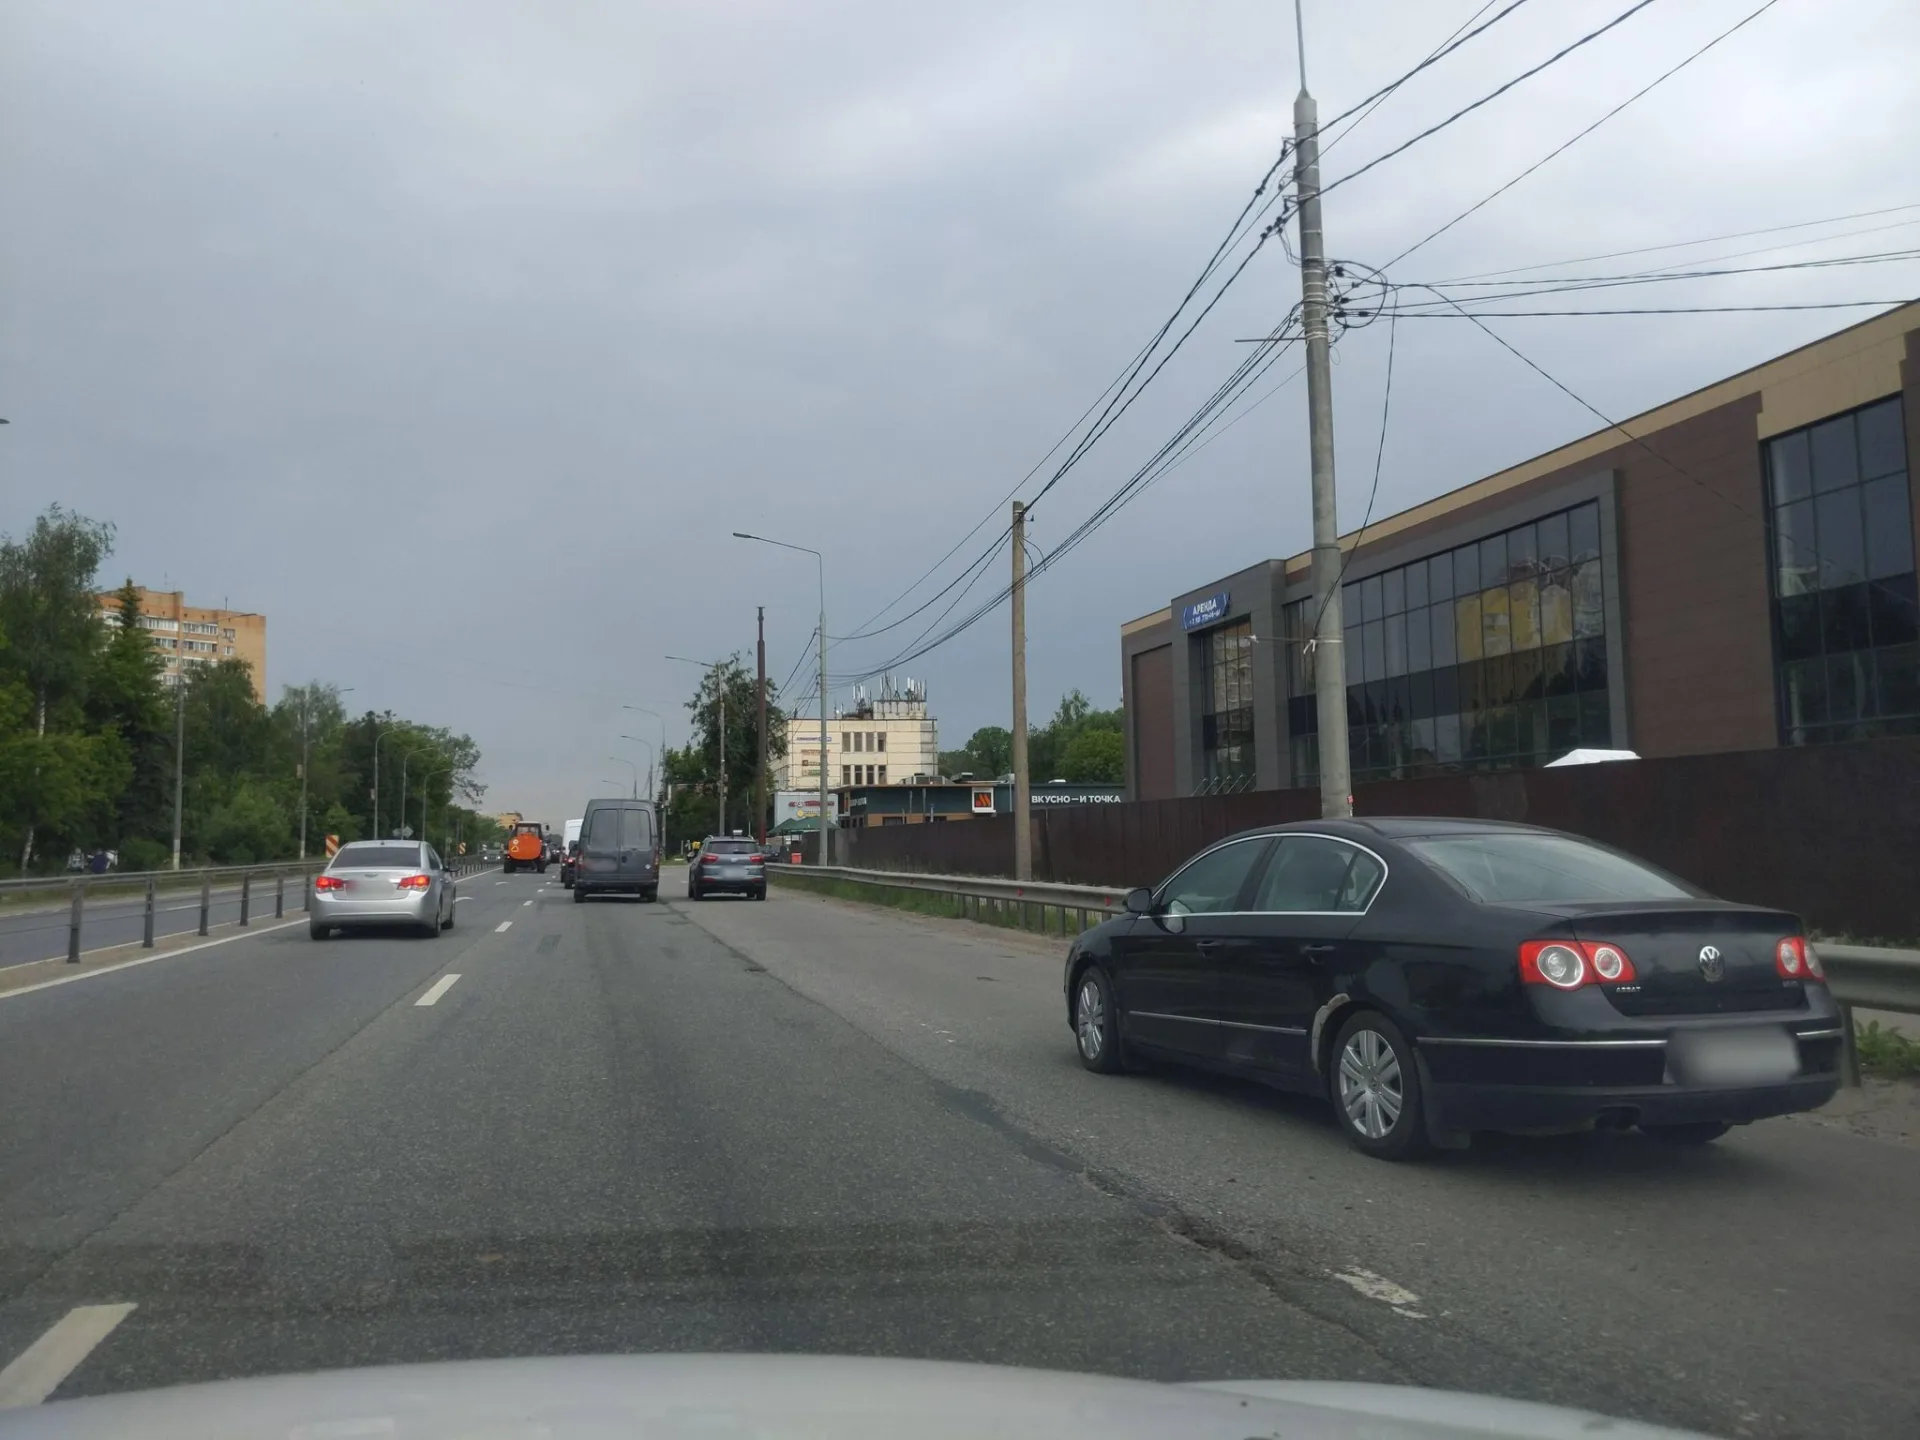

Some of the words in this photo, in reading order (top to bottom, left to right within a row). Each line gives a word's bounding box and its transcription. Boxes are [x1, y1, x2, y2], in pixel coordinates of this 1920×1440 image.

[1192, 598, 1217, 615] АРЕНДА
[1031, 795, 1071, 804] ВКУСНО
[1088, 795, 1121, 804] ТОЧКА
